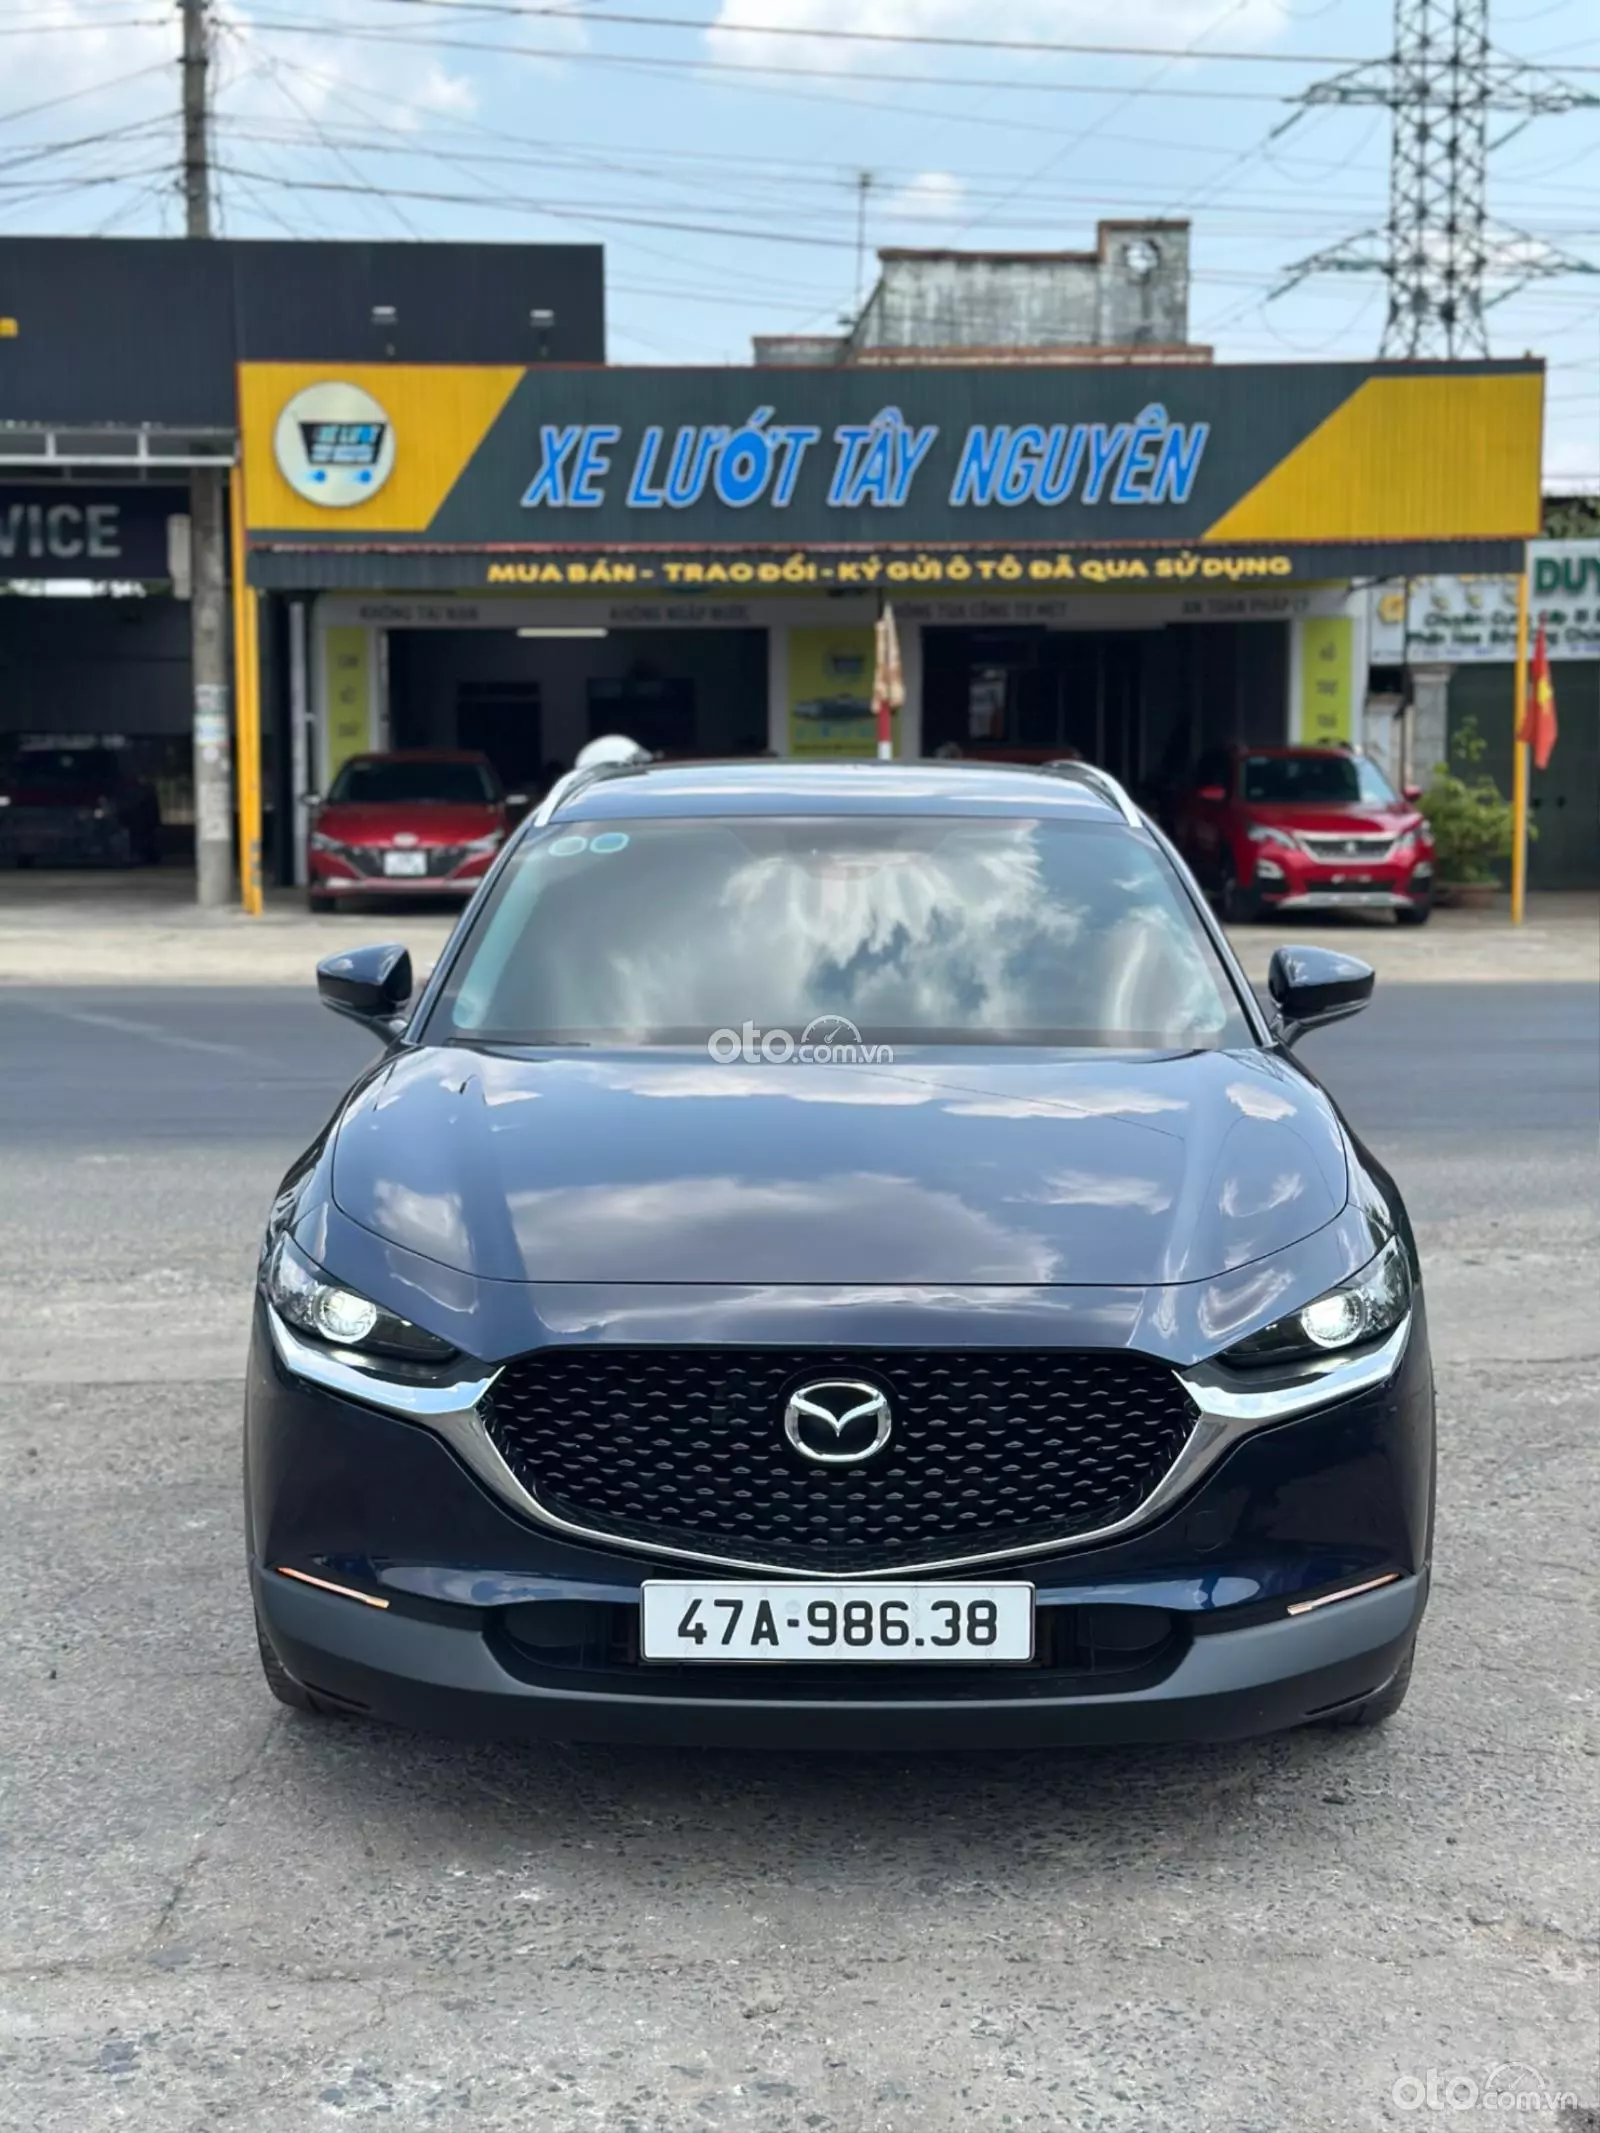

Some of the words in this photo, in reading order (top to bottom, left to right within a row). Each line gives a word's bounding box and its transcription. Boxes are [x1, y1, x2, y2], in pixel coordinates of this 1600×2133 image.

[521, 425, 622, 508] XE
[625, 405, 822, 508] LƯỚT
[828, 405, 939, 507] TÂY
[949, 402, 1210, 506] NGUYÊN
[487, 561, 562, 583] MUA
[568, 556, 635, 582] BÁN
[664, 562, 754, 582] TRAO
[946, 554, 972, 580] Ô
[976, 554, 1022, 580] TÔ
[1078, 557, 1148, 582] QUA
[677, 1599, 998, 1647] 47A-986.38
